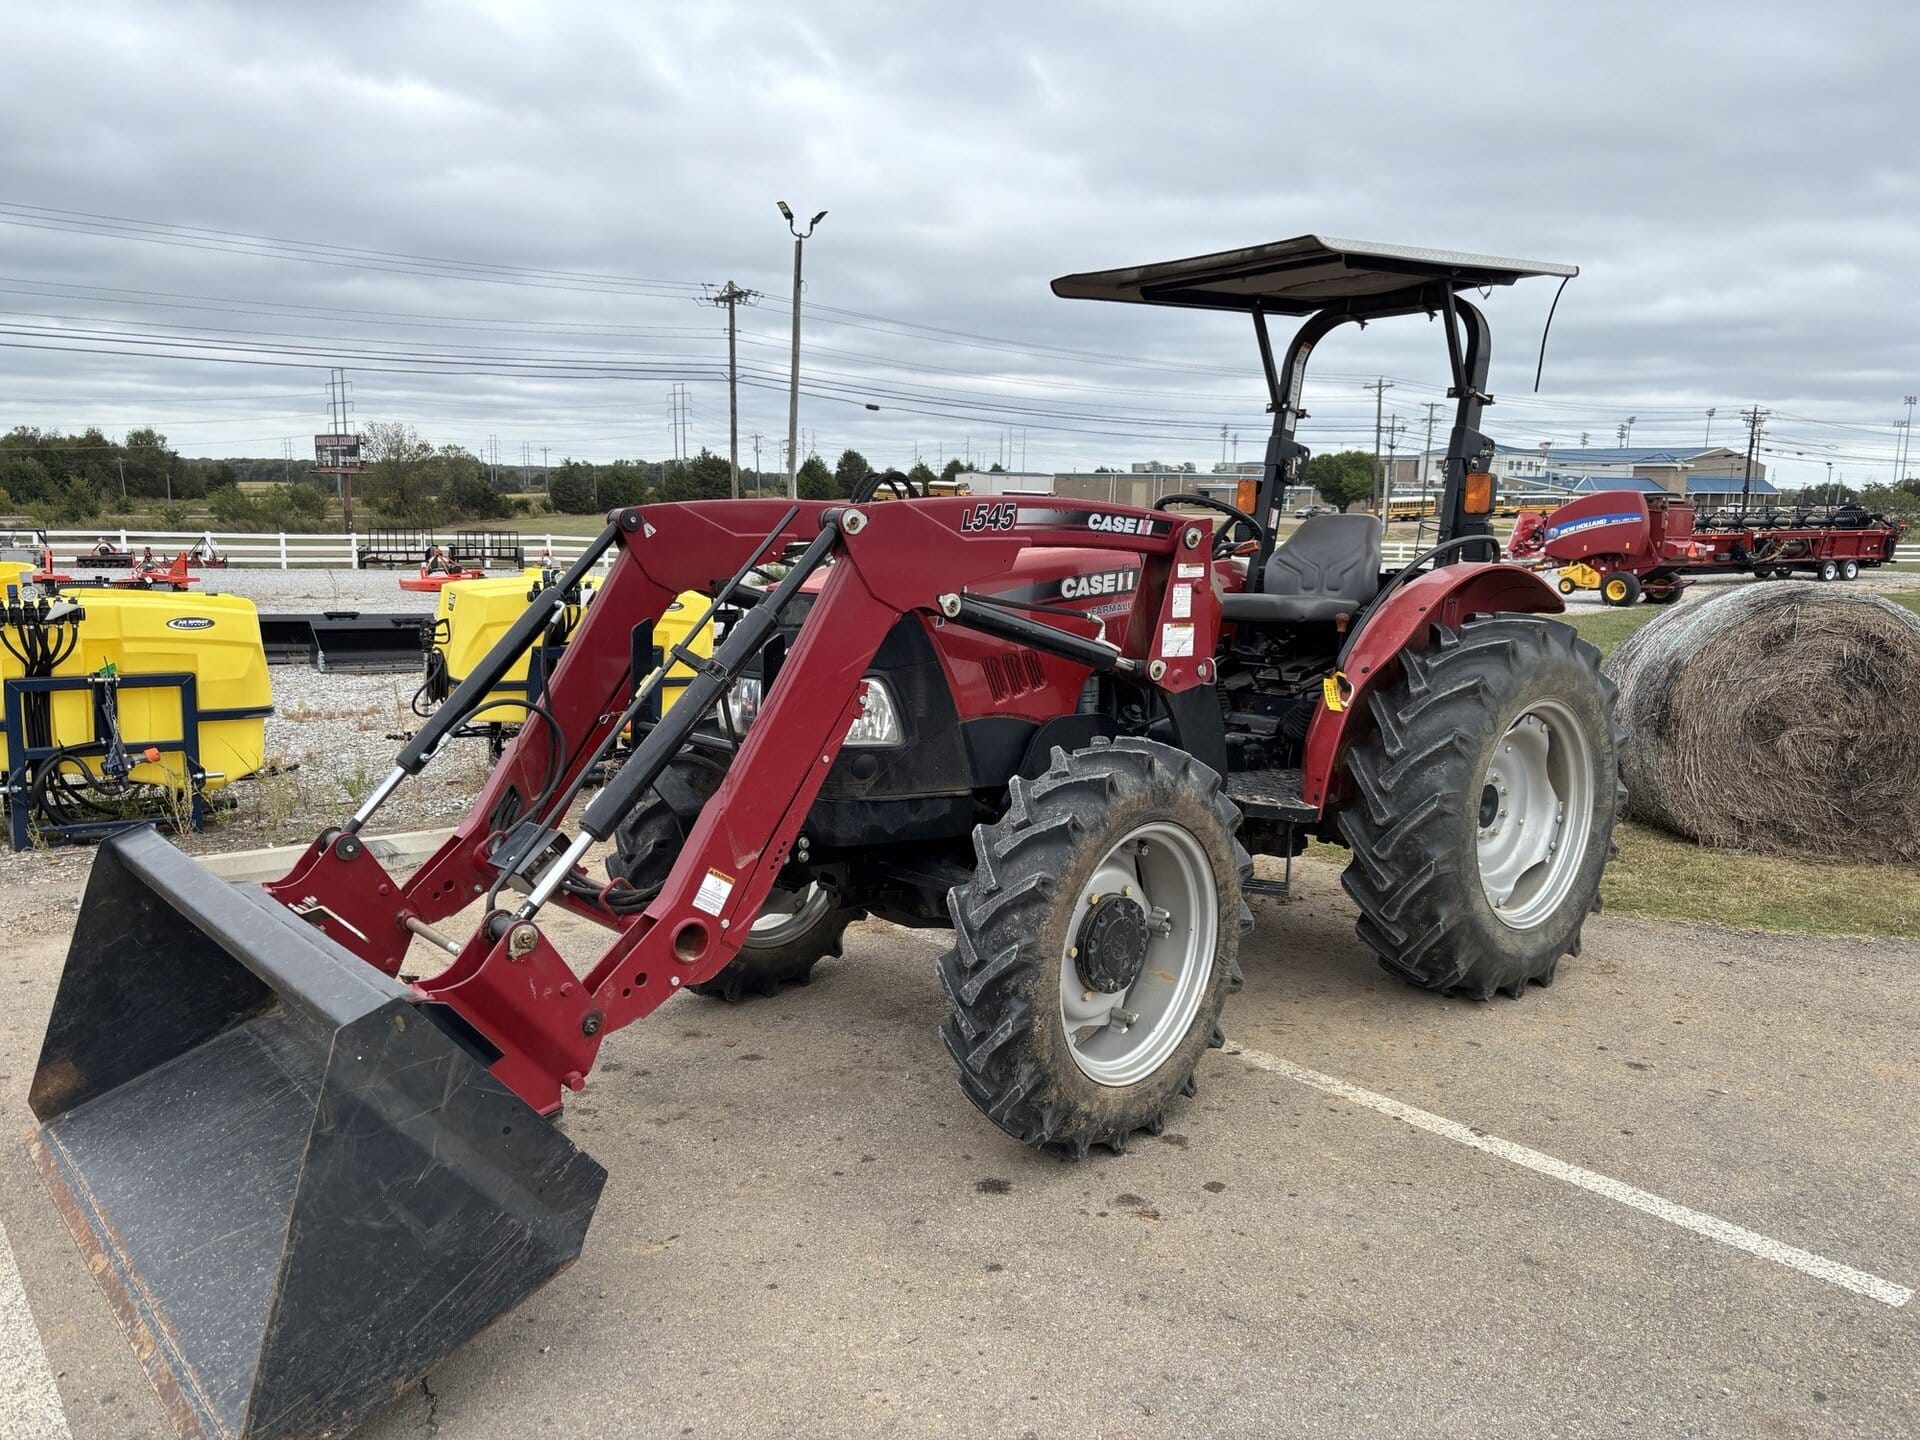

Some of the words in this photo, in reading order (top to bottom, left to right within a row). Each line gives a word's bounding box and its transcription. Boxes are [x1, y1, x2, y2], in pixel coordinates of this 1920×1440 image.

[961, 502, 1017, 532] L545
[1088, 513, 1135, 534] CASE
[1560, 526, 1576, 535] NEW
[1576, 519, 1607, 530] HOLLAND
[1061, 573, 1116, 599] CASE
